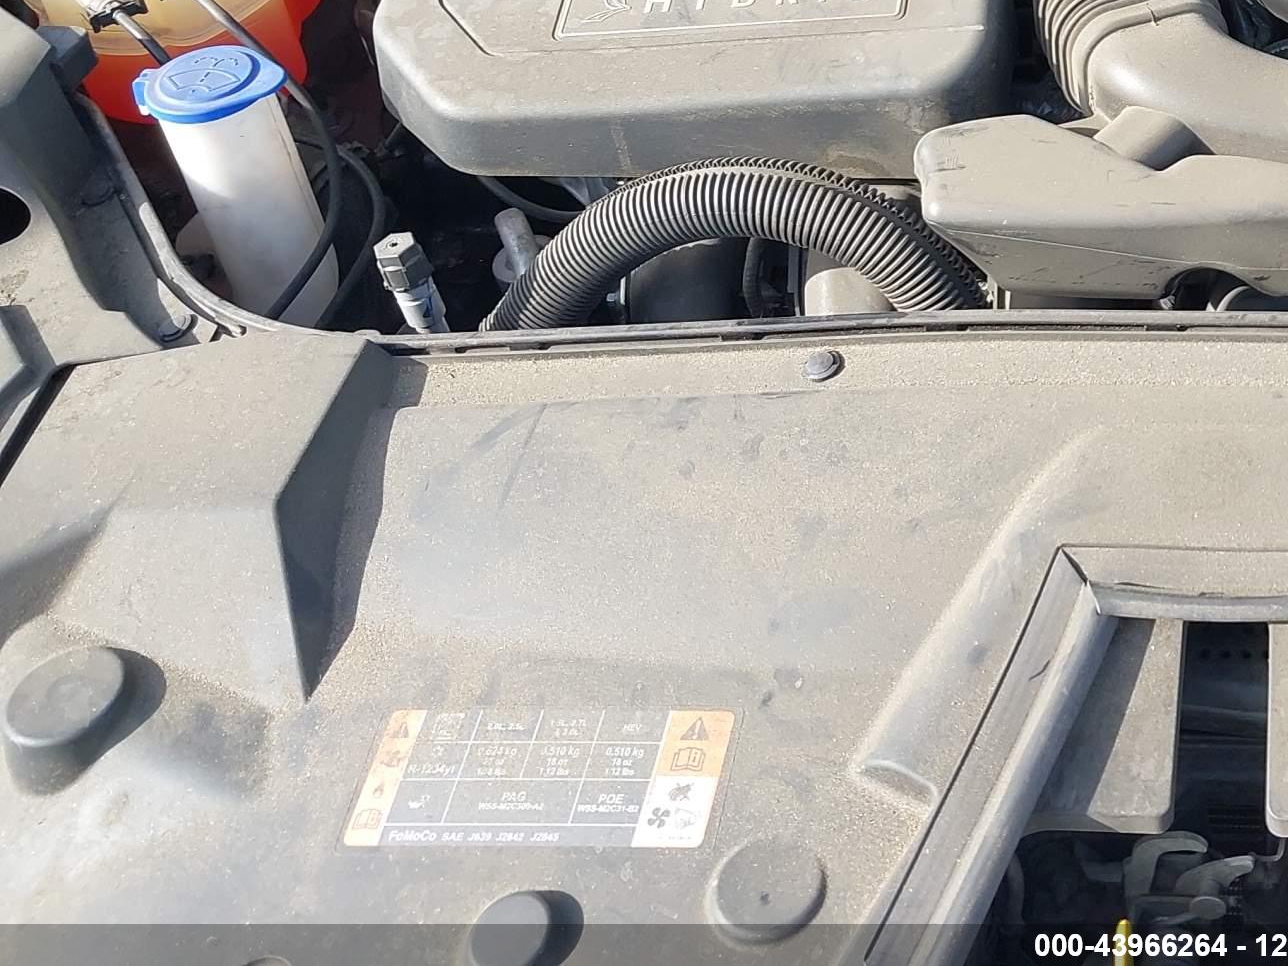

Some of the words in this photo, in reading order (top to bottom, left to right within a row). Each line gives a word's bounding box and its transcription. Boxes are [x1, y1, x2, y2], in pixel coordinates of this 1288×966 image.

[632, 747, 645, 759] kg
[501, 791, 527, 802] PAG
[598, 794, 625, 804] POE
[388, 829, 437, 841] FoMoCo
[441, 832, 465, 841] SAE
[467, 833, 492, 841] J639
